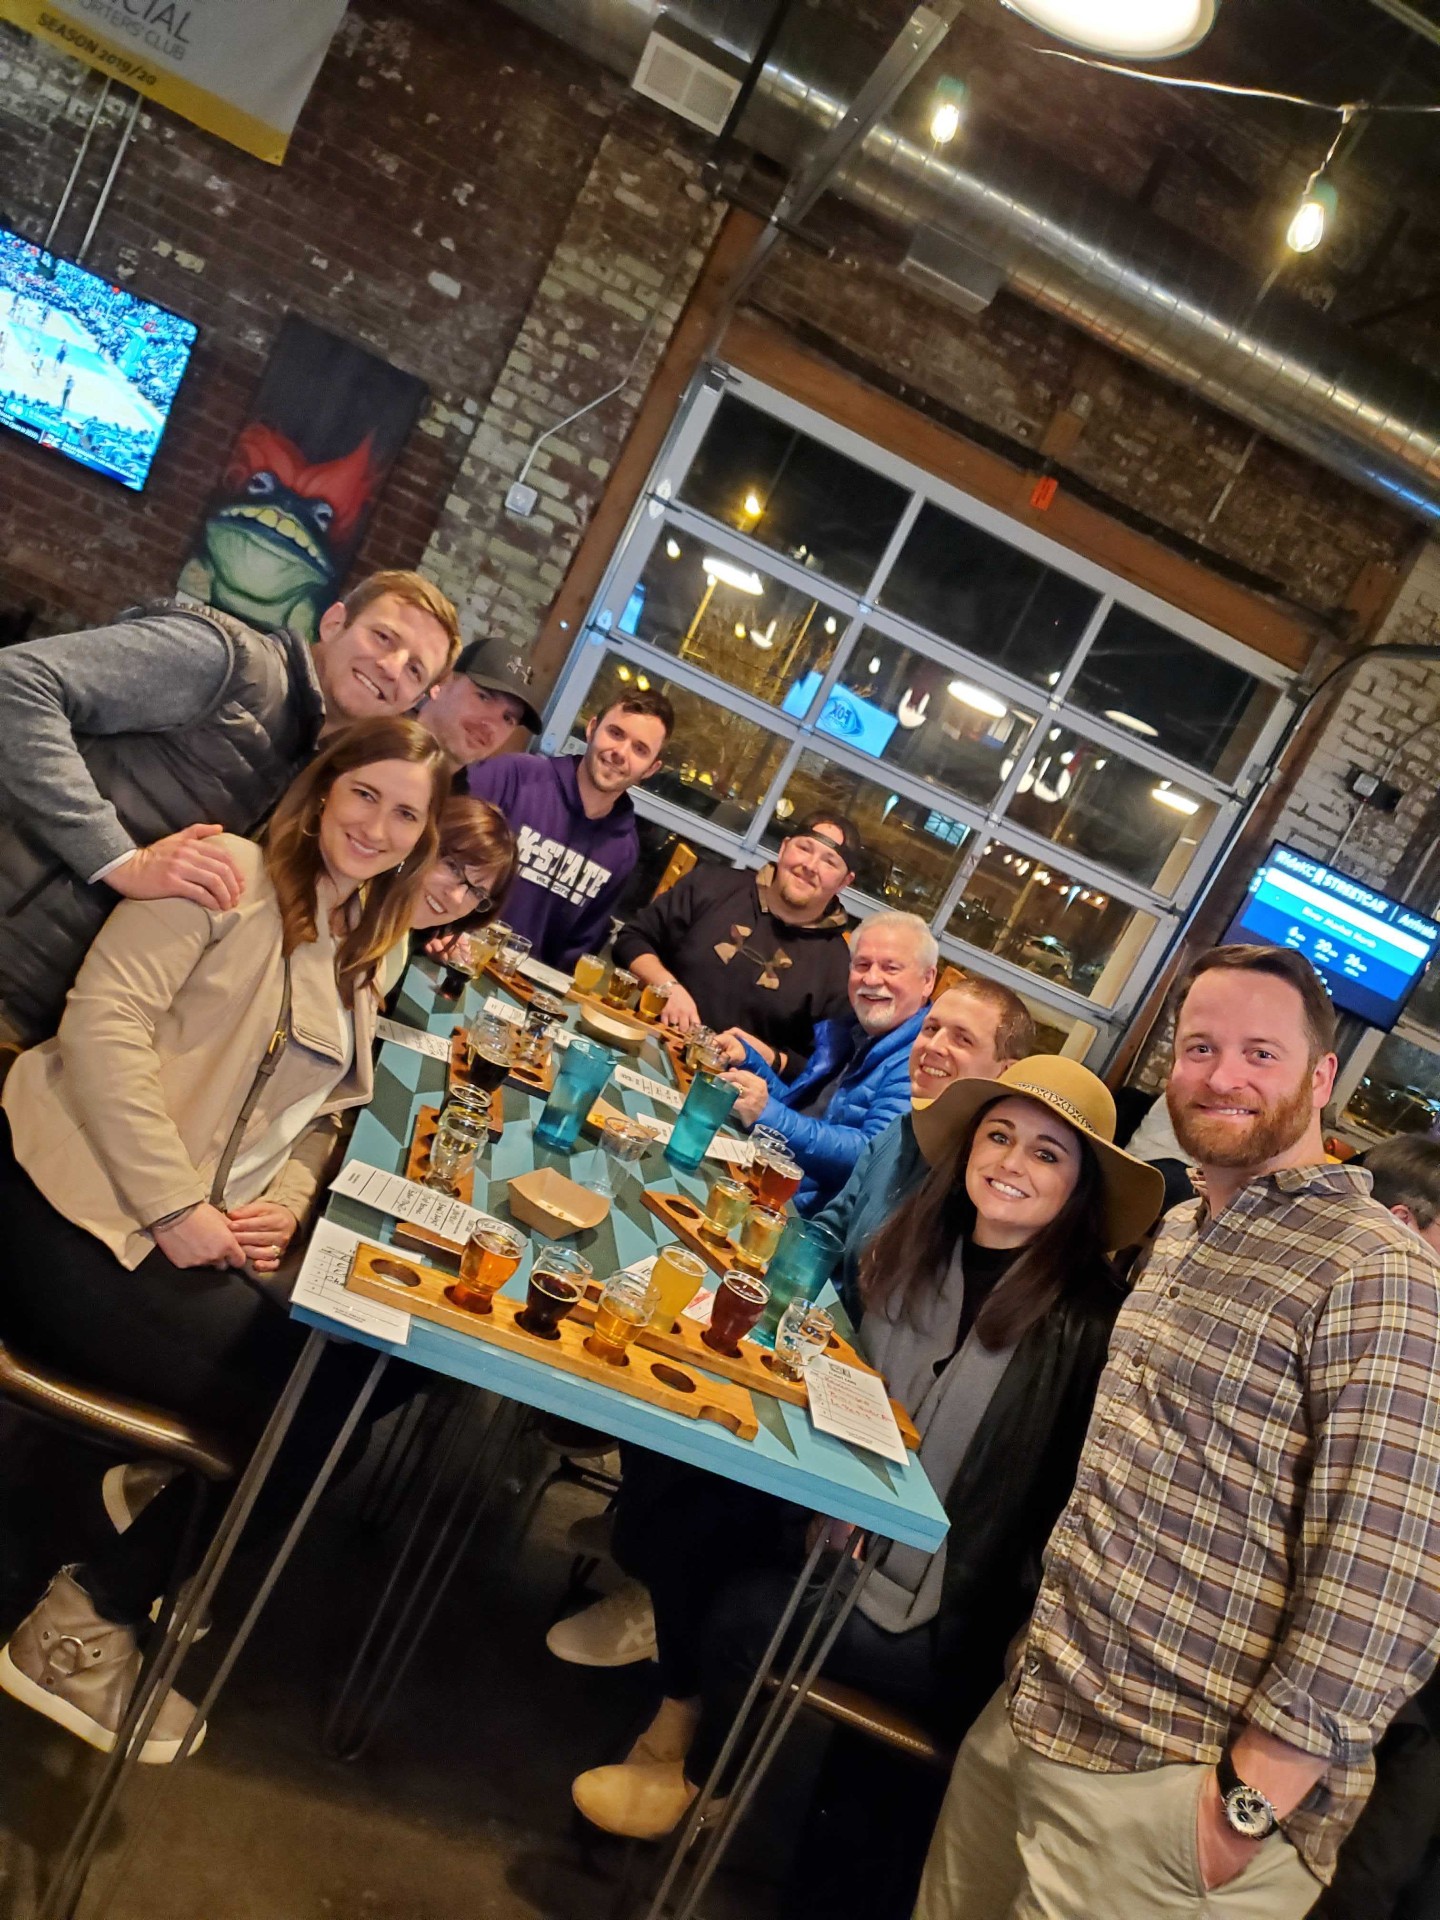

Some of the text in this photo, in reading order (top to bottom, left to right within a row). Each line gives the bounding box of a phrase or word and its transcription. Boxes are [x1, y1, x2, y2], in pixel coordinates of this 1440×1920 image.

[38, 12, 156, 85] SEASON 2019/20
[112, 0, 189, 43] CIAL
[145, 29, 186, 60] CLUB
[517, 825, 612, 898] K-STATE
[1322, 874, 1389, 914] STREETCAR
[1397, 913, 1438, 940] Arrivals
